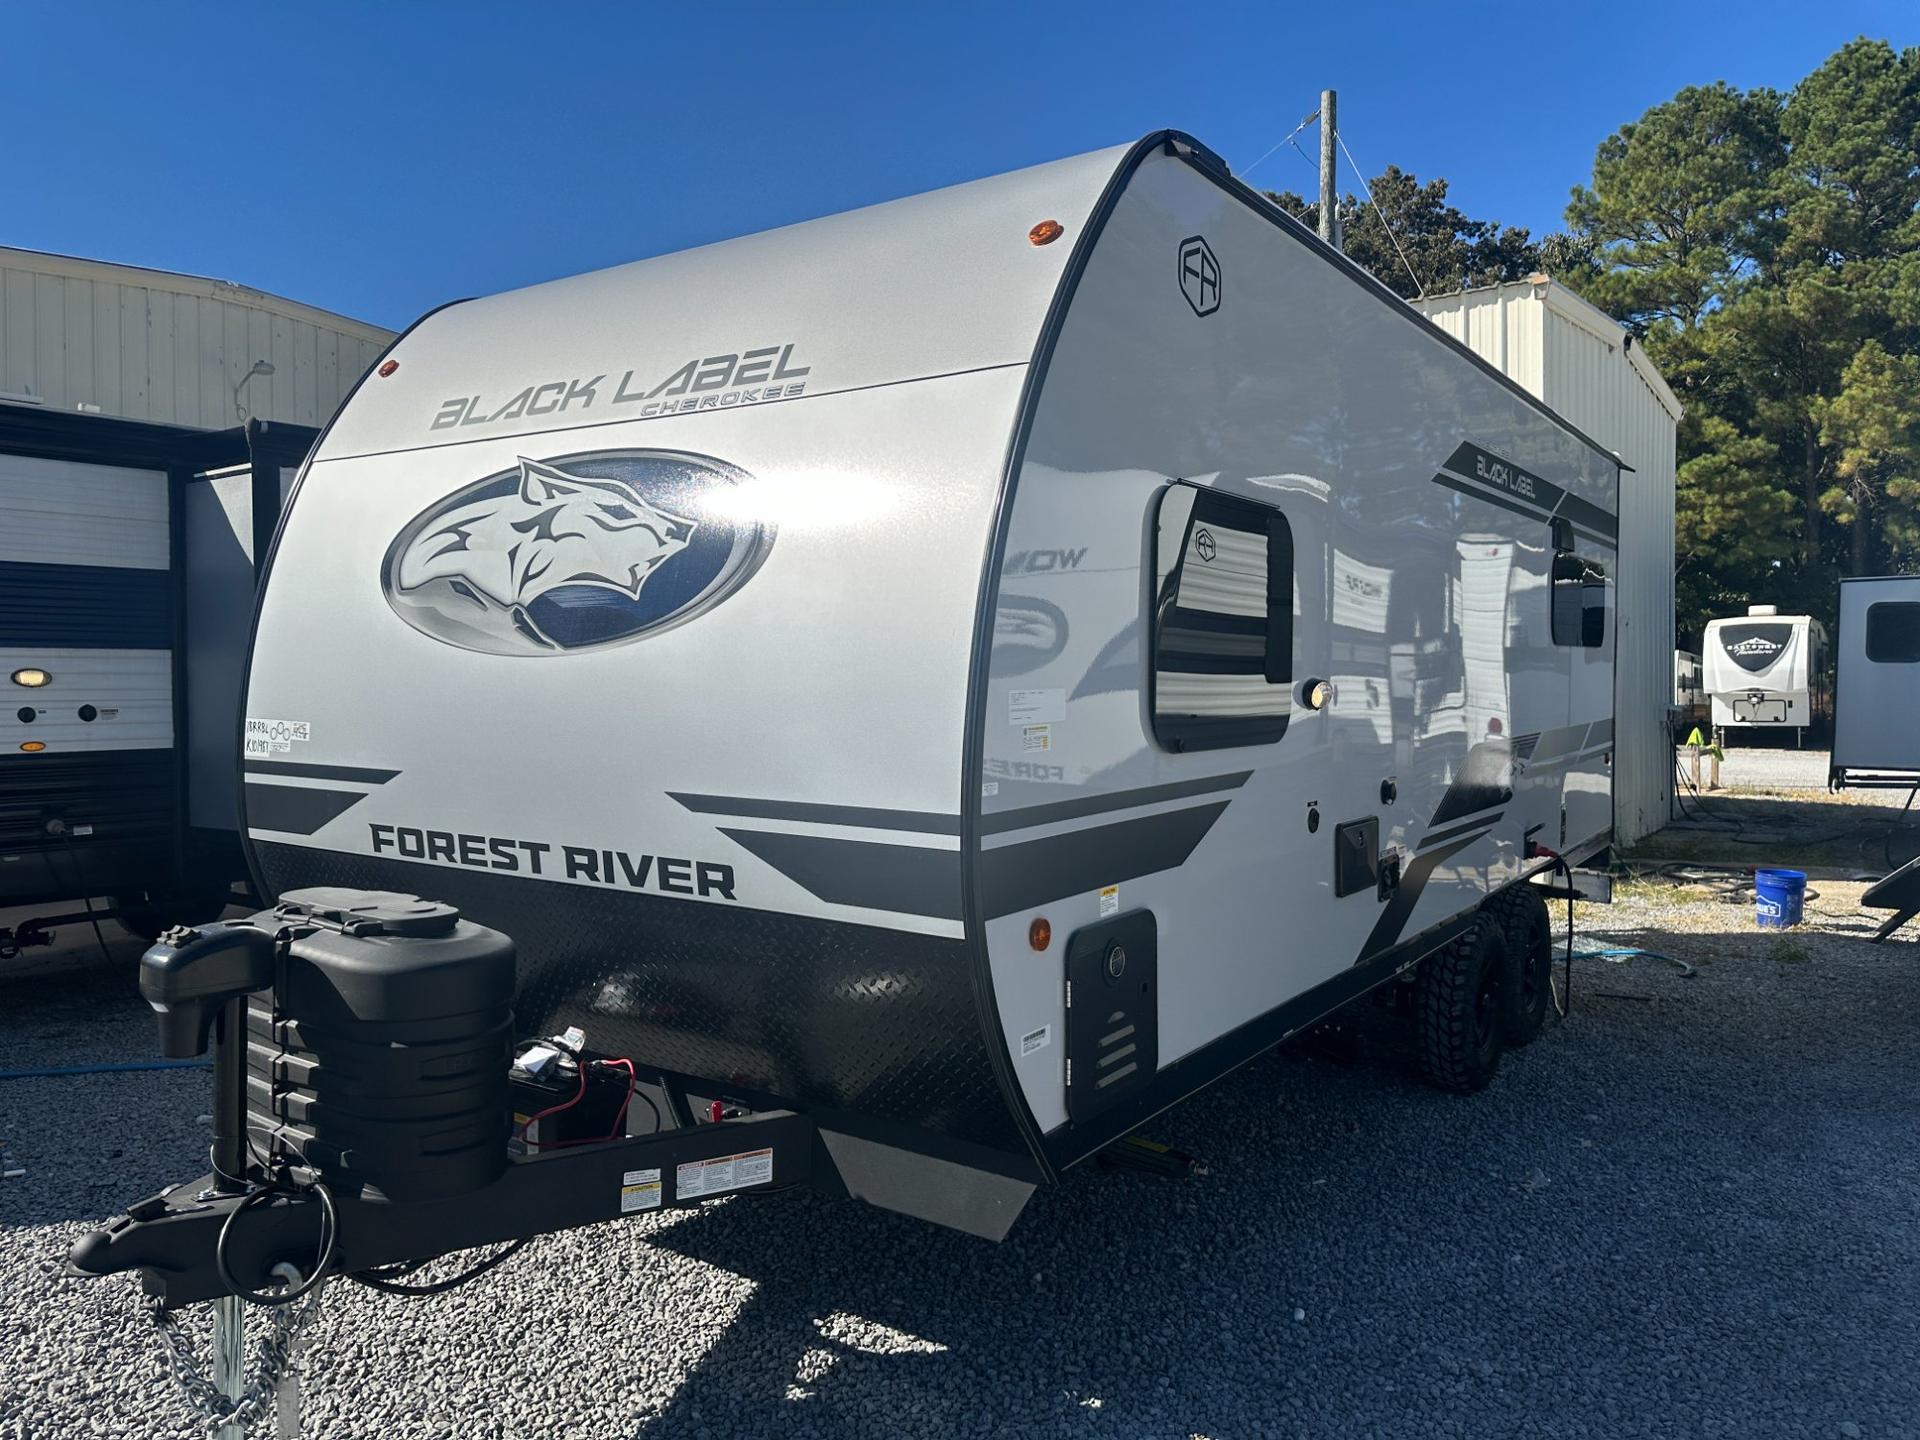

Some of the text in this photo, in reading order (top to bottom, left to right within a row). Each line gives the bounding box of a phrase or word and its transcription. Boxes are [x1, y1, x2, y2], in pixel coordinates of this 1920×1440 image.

[430, 344, 811, 431] BLACK LABEL
[640, 381, 807, 416] CHEROKEE
[1476, 455, 1536, 499] BLACK LABEL
[368, 823, 738, 900] FOREST RIVER
